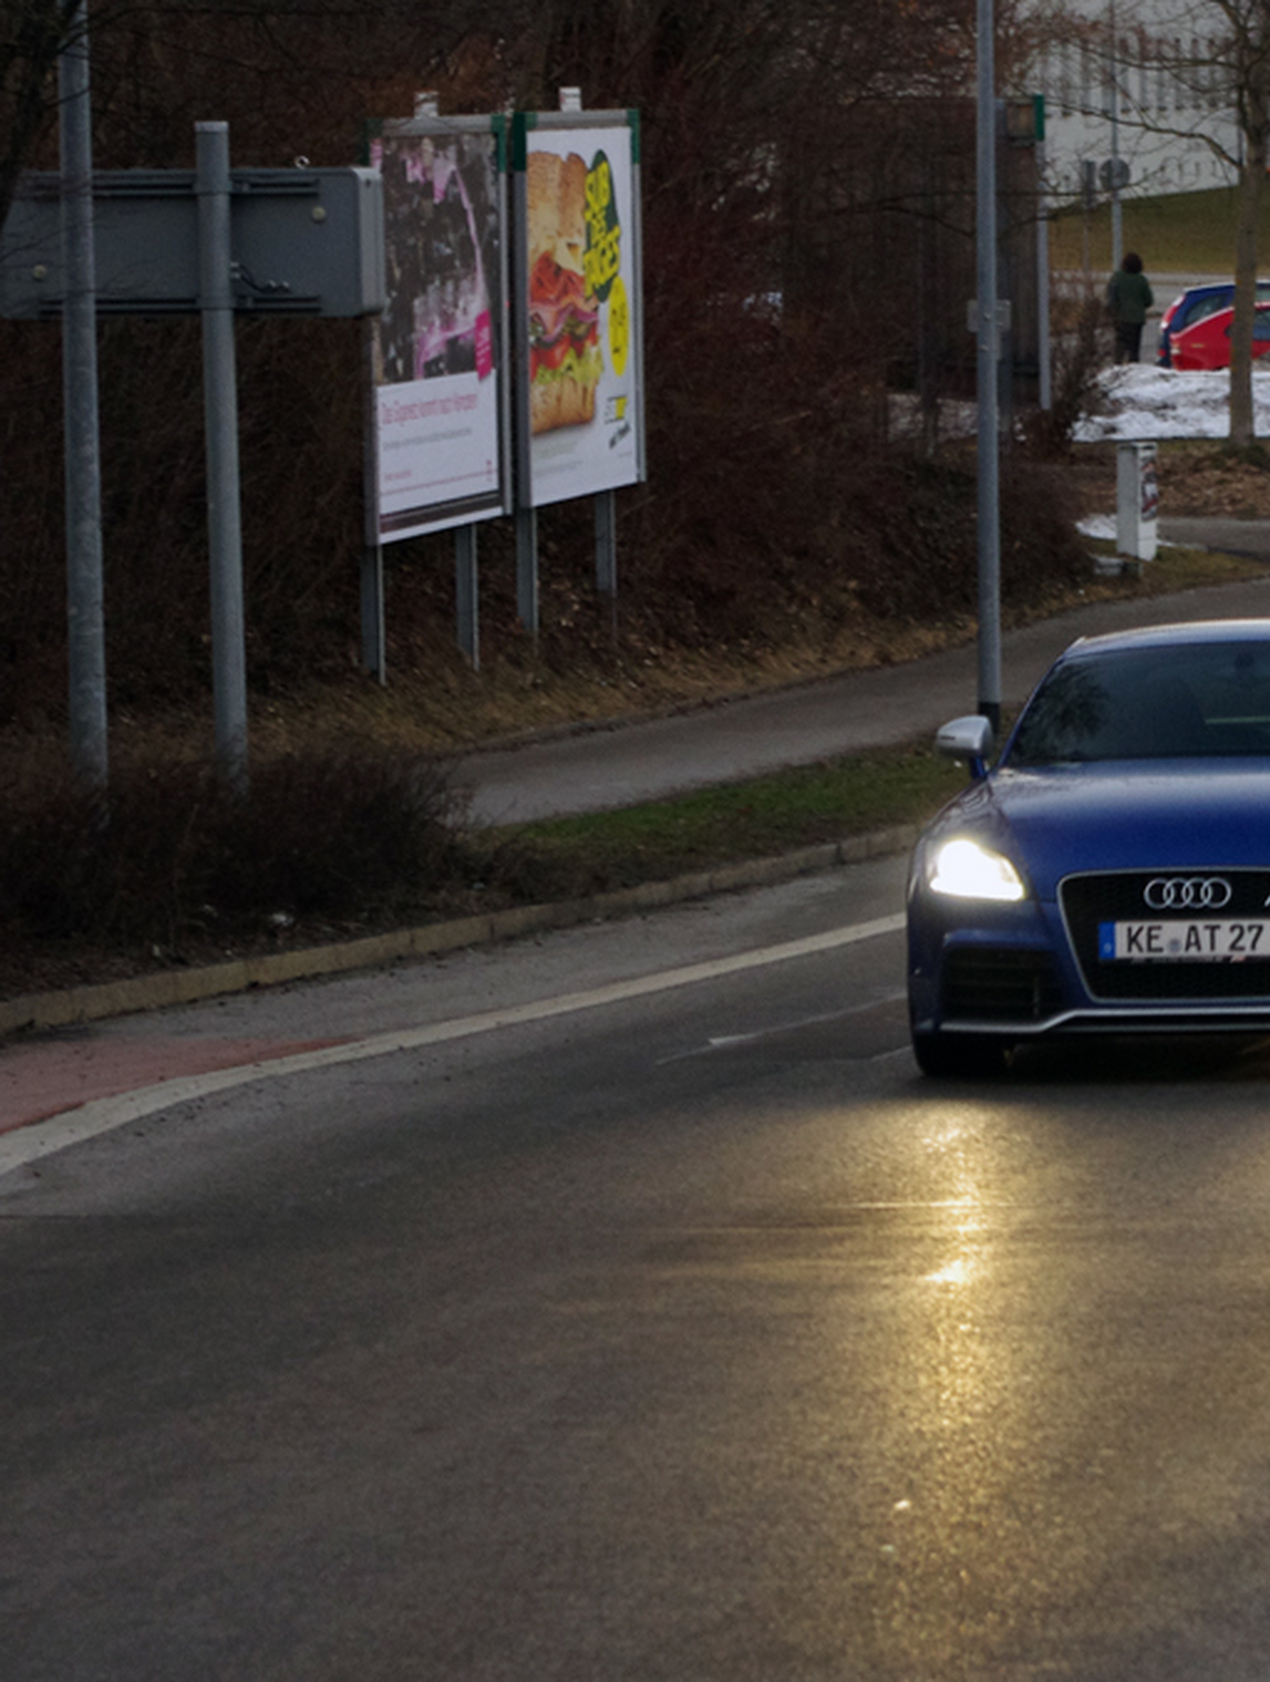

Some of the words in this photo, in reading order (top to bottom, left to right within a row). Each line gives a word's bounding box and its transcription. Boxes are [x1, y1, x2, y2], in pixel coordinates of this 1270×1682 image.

[1127, 925, 1164, 953] KE
[1184, 924, 1222, 952] AT
[1229, 923, 1264, 951] 27
